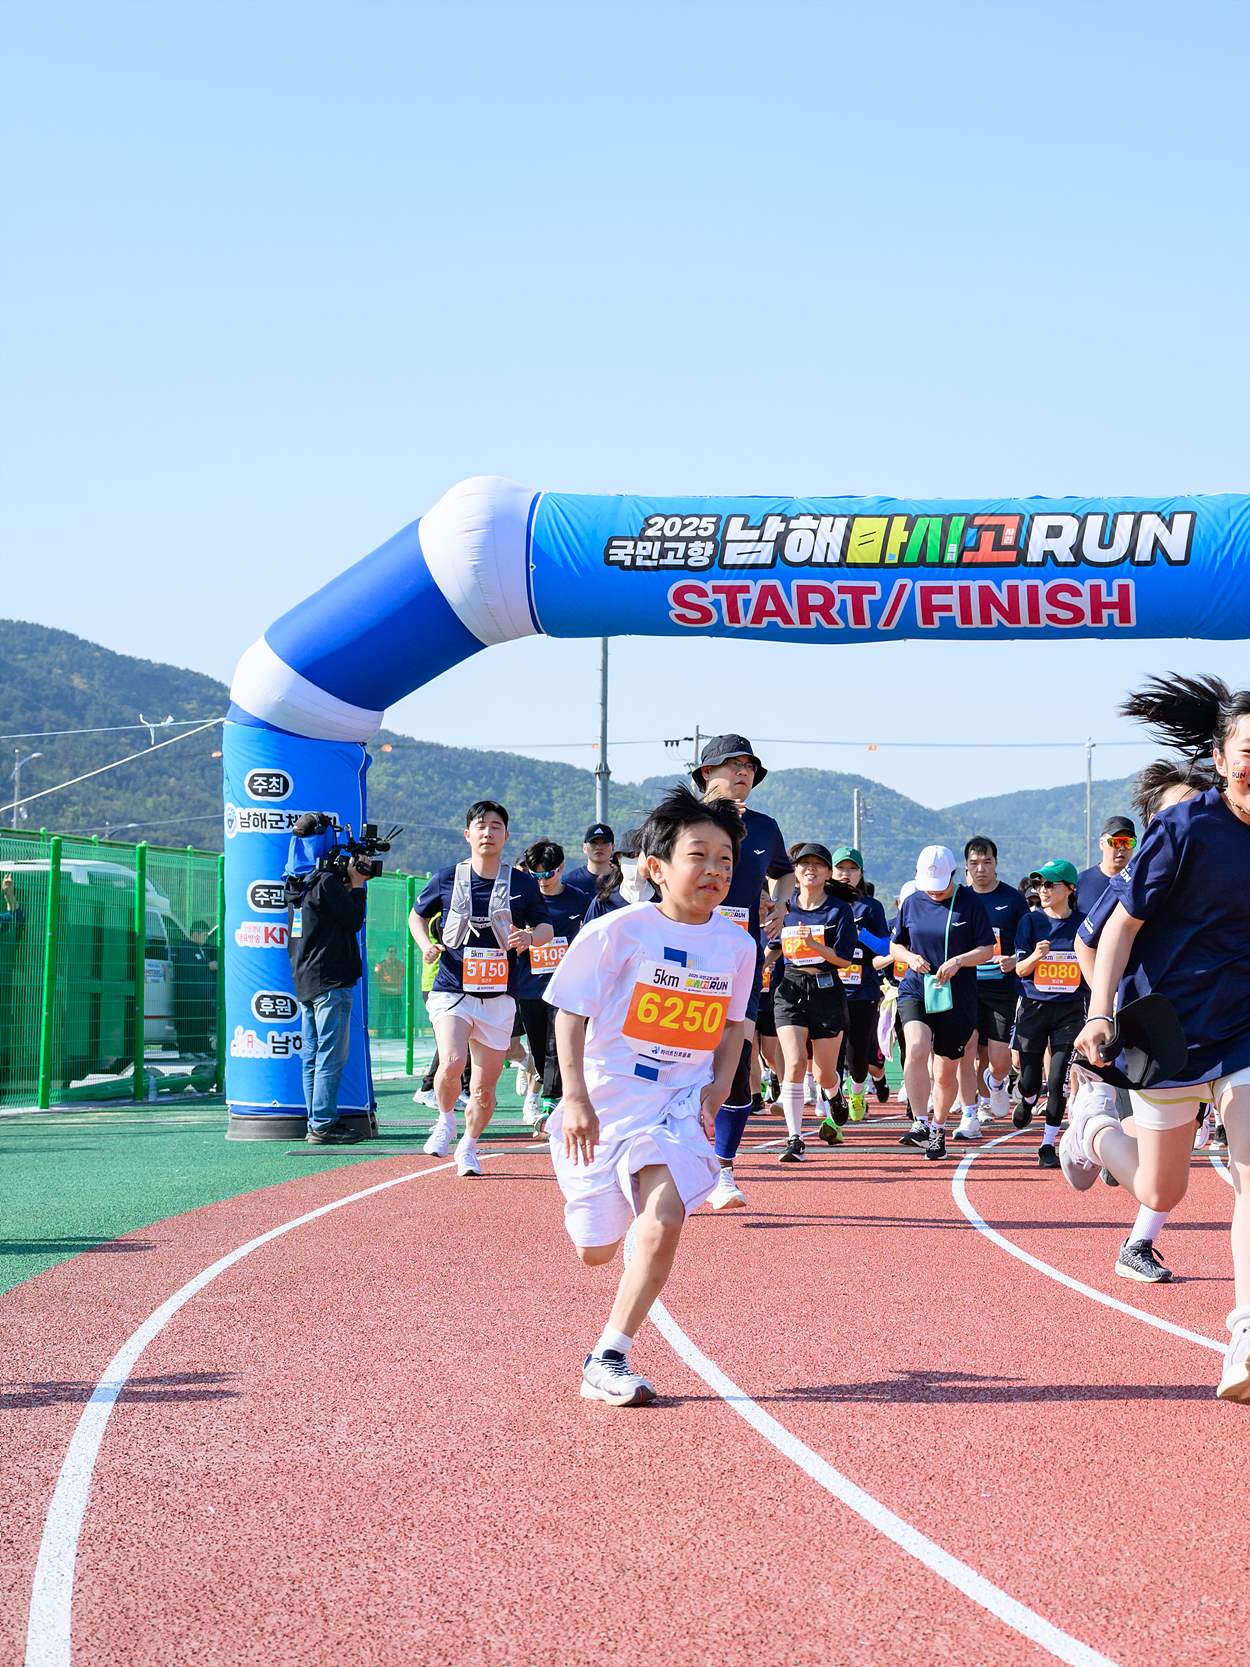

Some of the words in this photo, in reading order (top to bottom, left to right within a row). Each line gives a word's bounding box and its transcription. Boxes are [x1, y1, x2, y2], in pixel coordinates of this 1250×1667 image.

[645, 516, 717, 537] 2025
[608, 540, 715, 567] 국민고향
[252, 776, 283, 793] 주최
[533, 947, 566, 963] 5108
[467, 961, 506, 977] 5150
[653, 968, 680, 988] 5km
[1038, 963, 1078, 979] 6080
[259, 997, 292, 1015] 후원
[637, 992, 723, 1033] 6250
